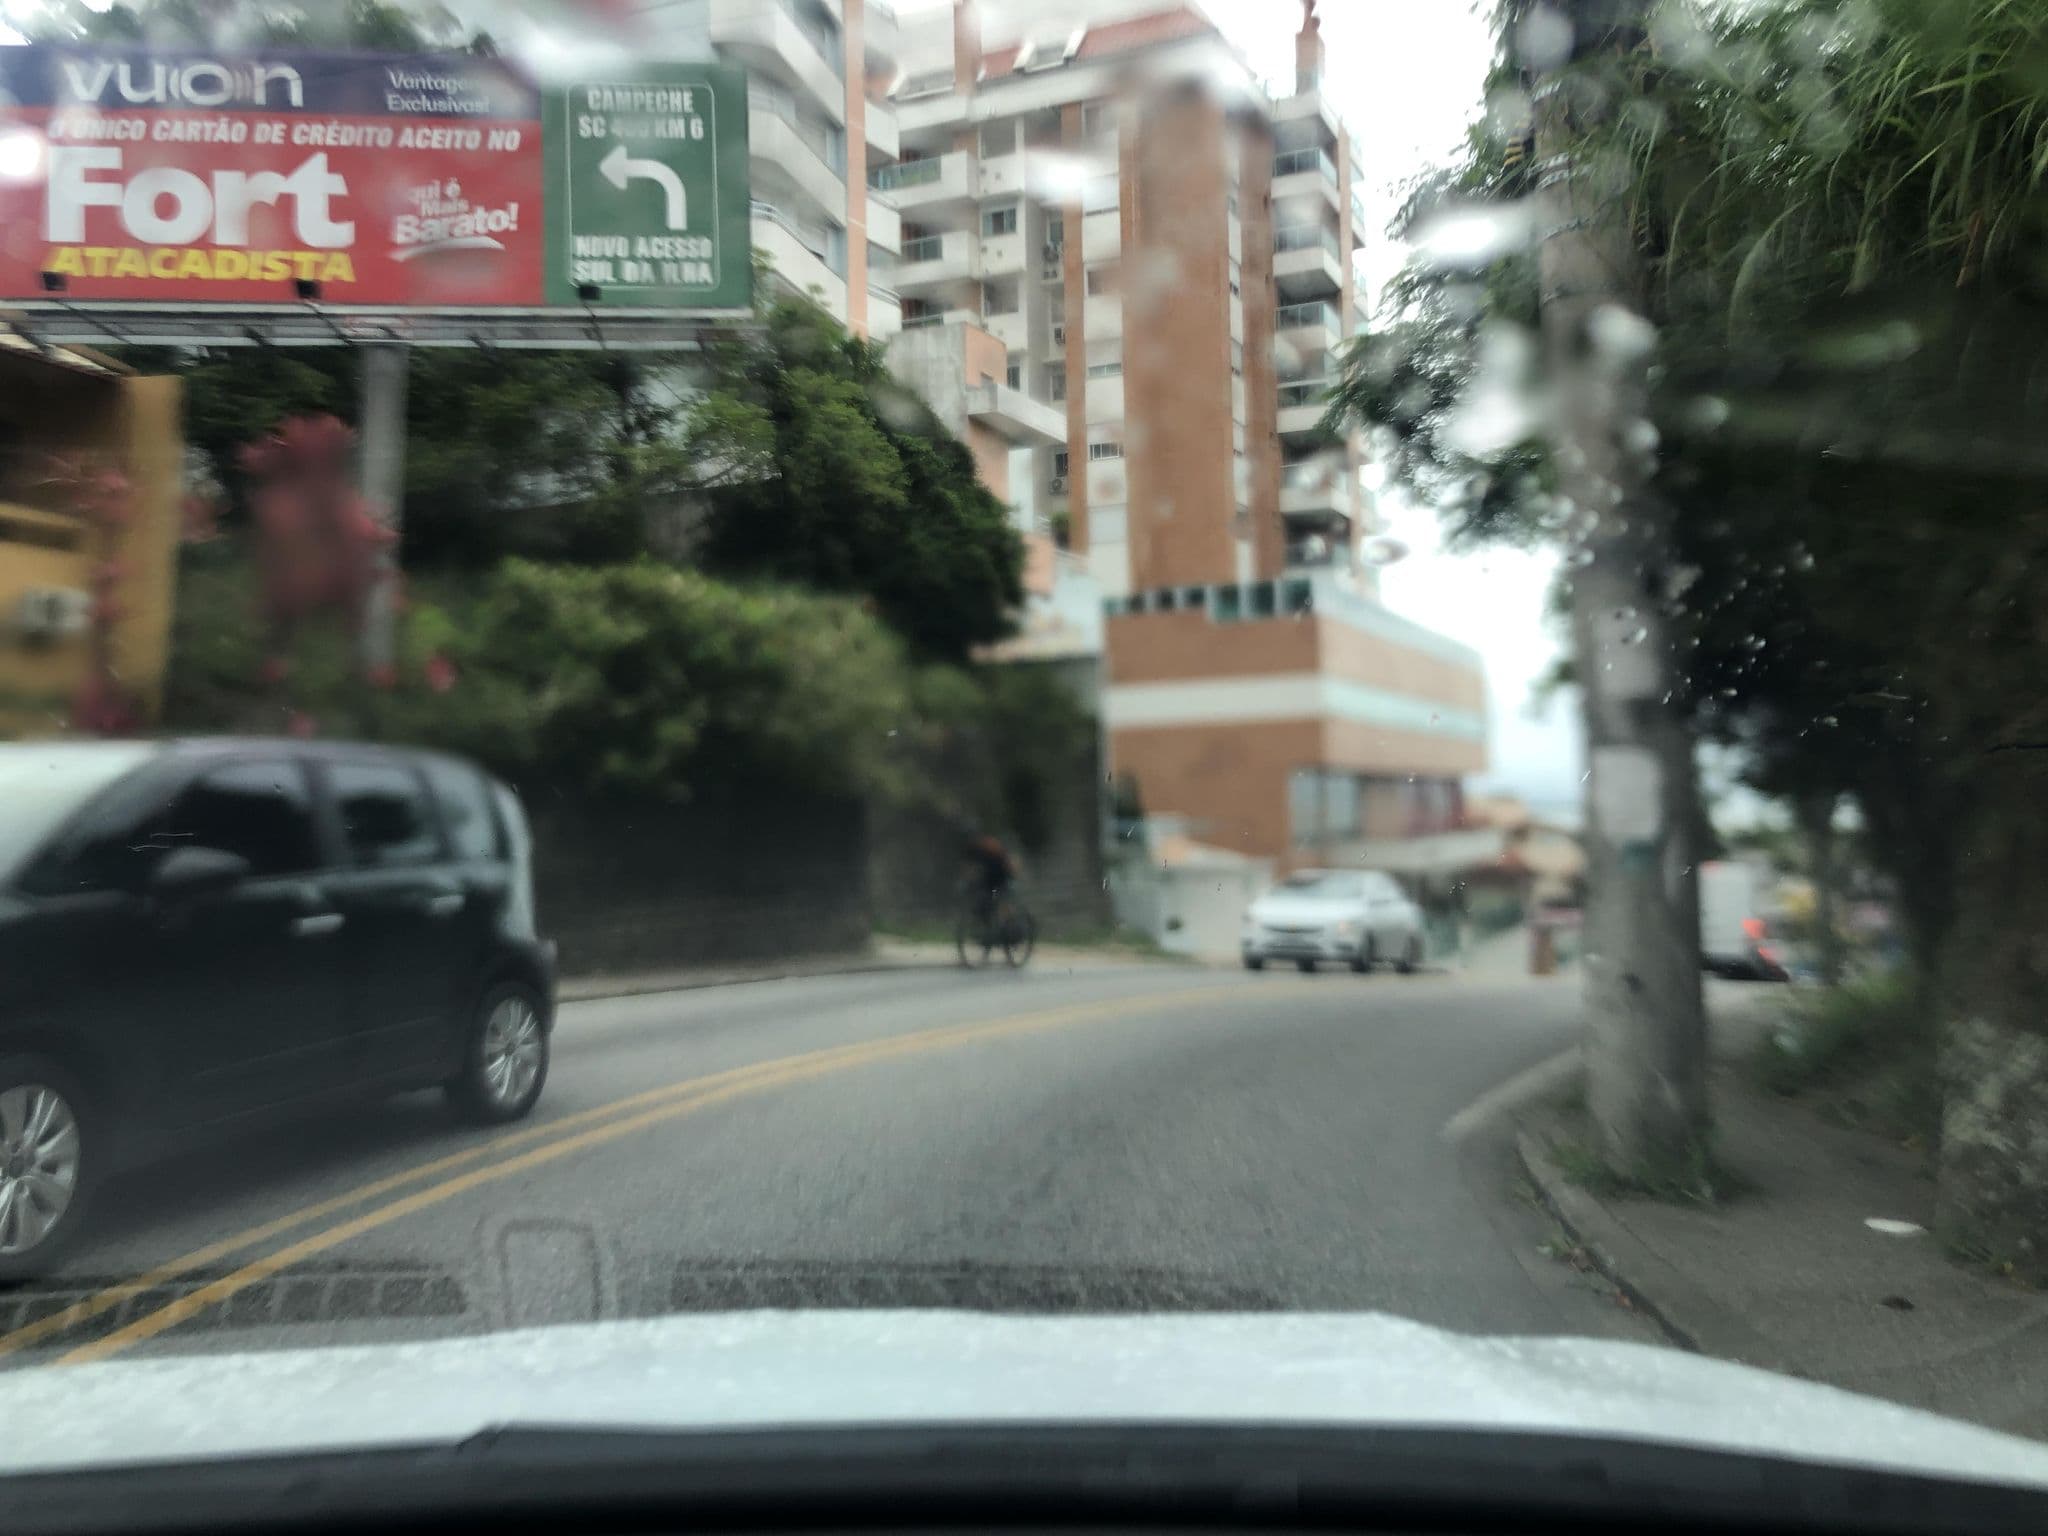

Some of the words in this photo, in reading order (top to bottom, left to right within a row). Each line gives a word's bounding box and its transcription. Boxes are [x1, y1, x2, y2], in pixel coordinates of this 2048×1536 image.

[388, 69, 481, 94] Vantage
[586, 88, 694, 113] CAMPECHE
[151, 116, 249, 144] CARTÃO
[253, 121, 288, 145] DE
[291, 120, 394, 148] CRÉDITO
[398, 125, 483, 150] ACEITO
[487, 128, 522, 152] NO
[578, 114, 607, 139] SC
[44, 145, 356, 249] Fort
[394, 201, 519, 245] Barato!
[49, 246, 358, 283] ATACADISTA
